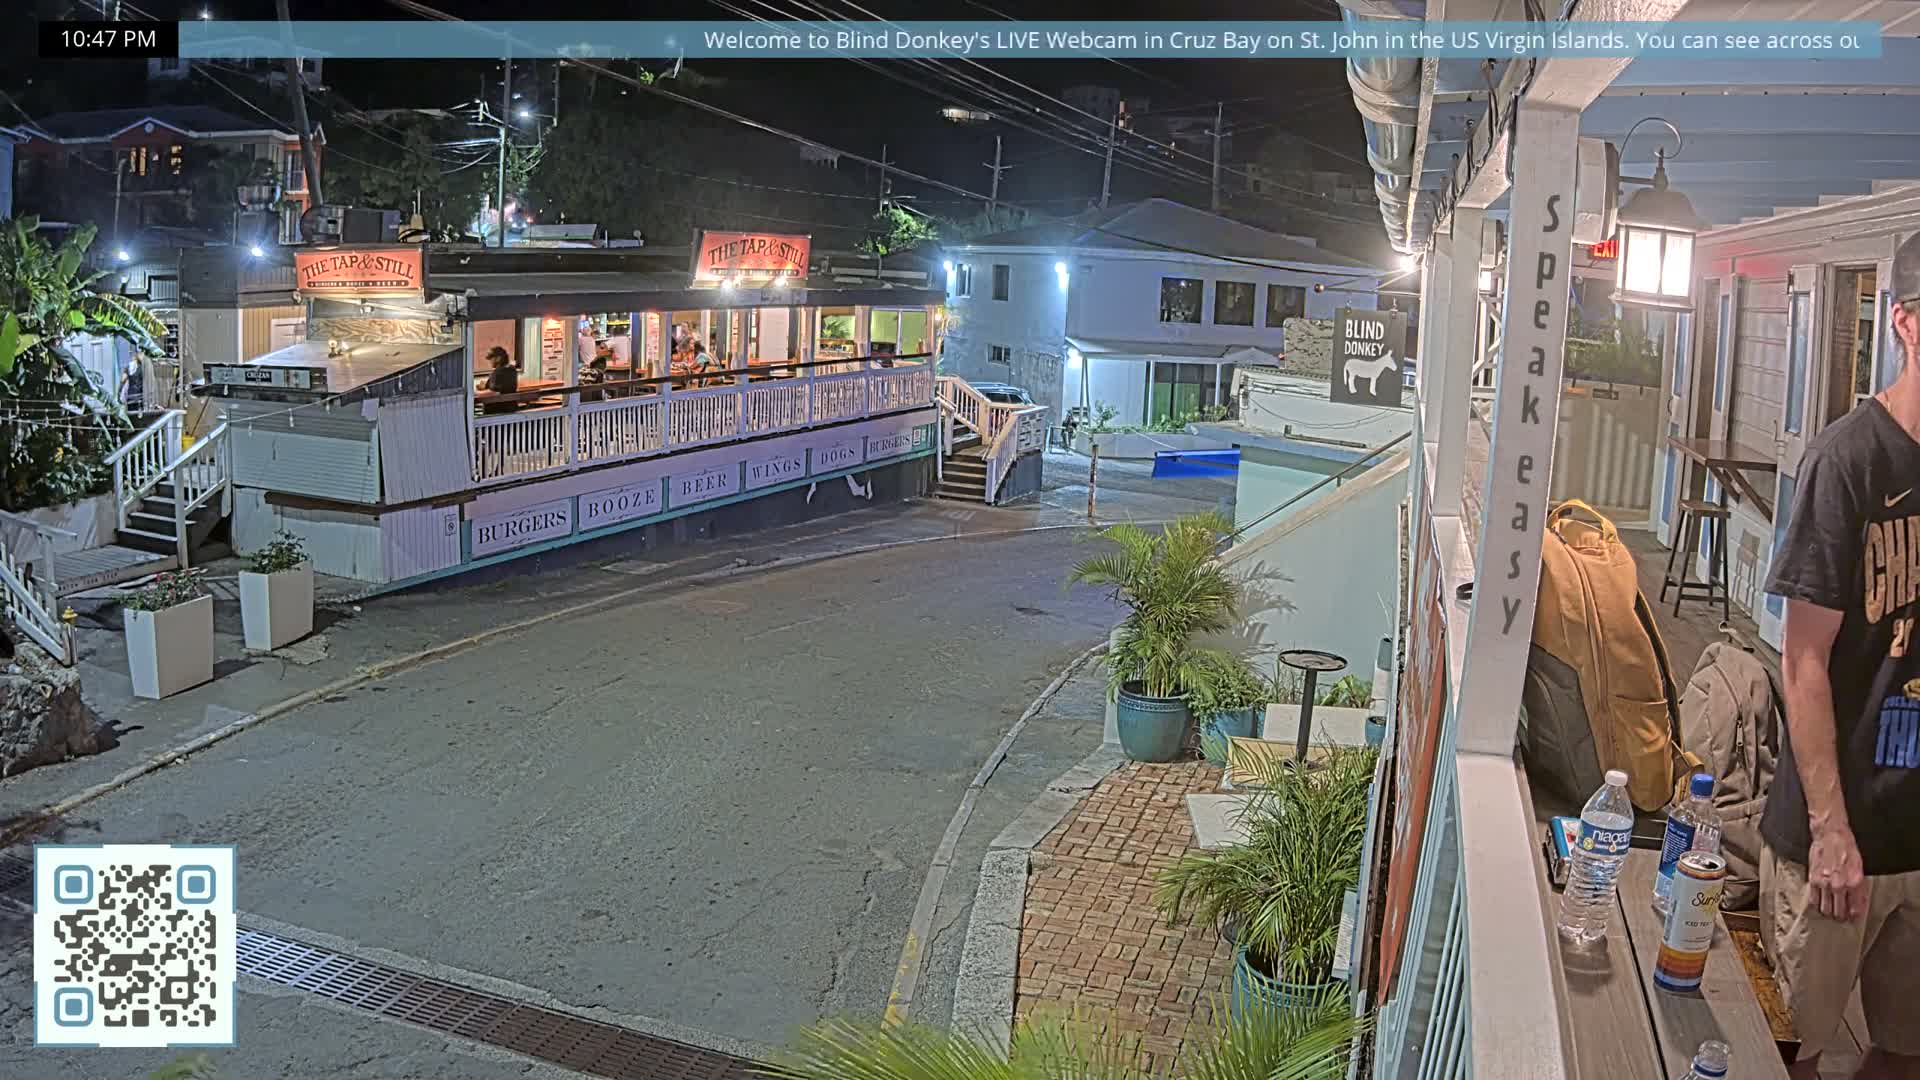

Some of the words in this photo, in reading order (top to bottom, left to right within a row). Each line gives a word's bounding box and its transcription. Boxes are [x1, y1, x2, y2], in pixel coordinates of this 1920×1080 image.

[708, 241, 738, 266] THE
[740, 238, 766, 256] TAP
[763, 238, 780, 257] &
[779, 242, 805, 269] STILL
[302, 259, 330, 280] THE
[330, 255, 358, 271] TAP
[357, 254, 375, 270] &
[374, 256, 414, 280] STILL
[1345, 319, 1385, 340] BLIND
[1344, 341, 1385, 356] DONKEY
[1500, 193, 1562, 636] Speakeasy
[868, 432, 912, 453] BURGERS
[820, 447, 856, 466] DOGS
[751, 457, 801, 481] WINGS
[681, 473, 728, 496] BEER
[588, 488, 656, 518] BOOZE
[477, 509, 568, 545] BURGERS
